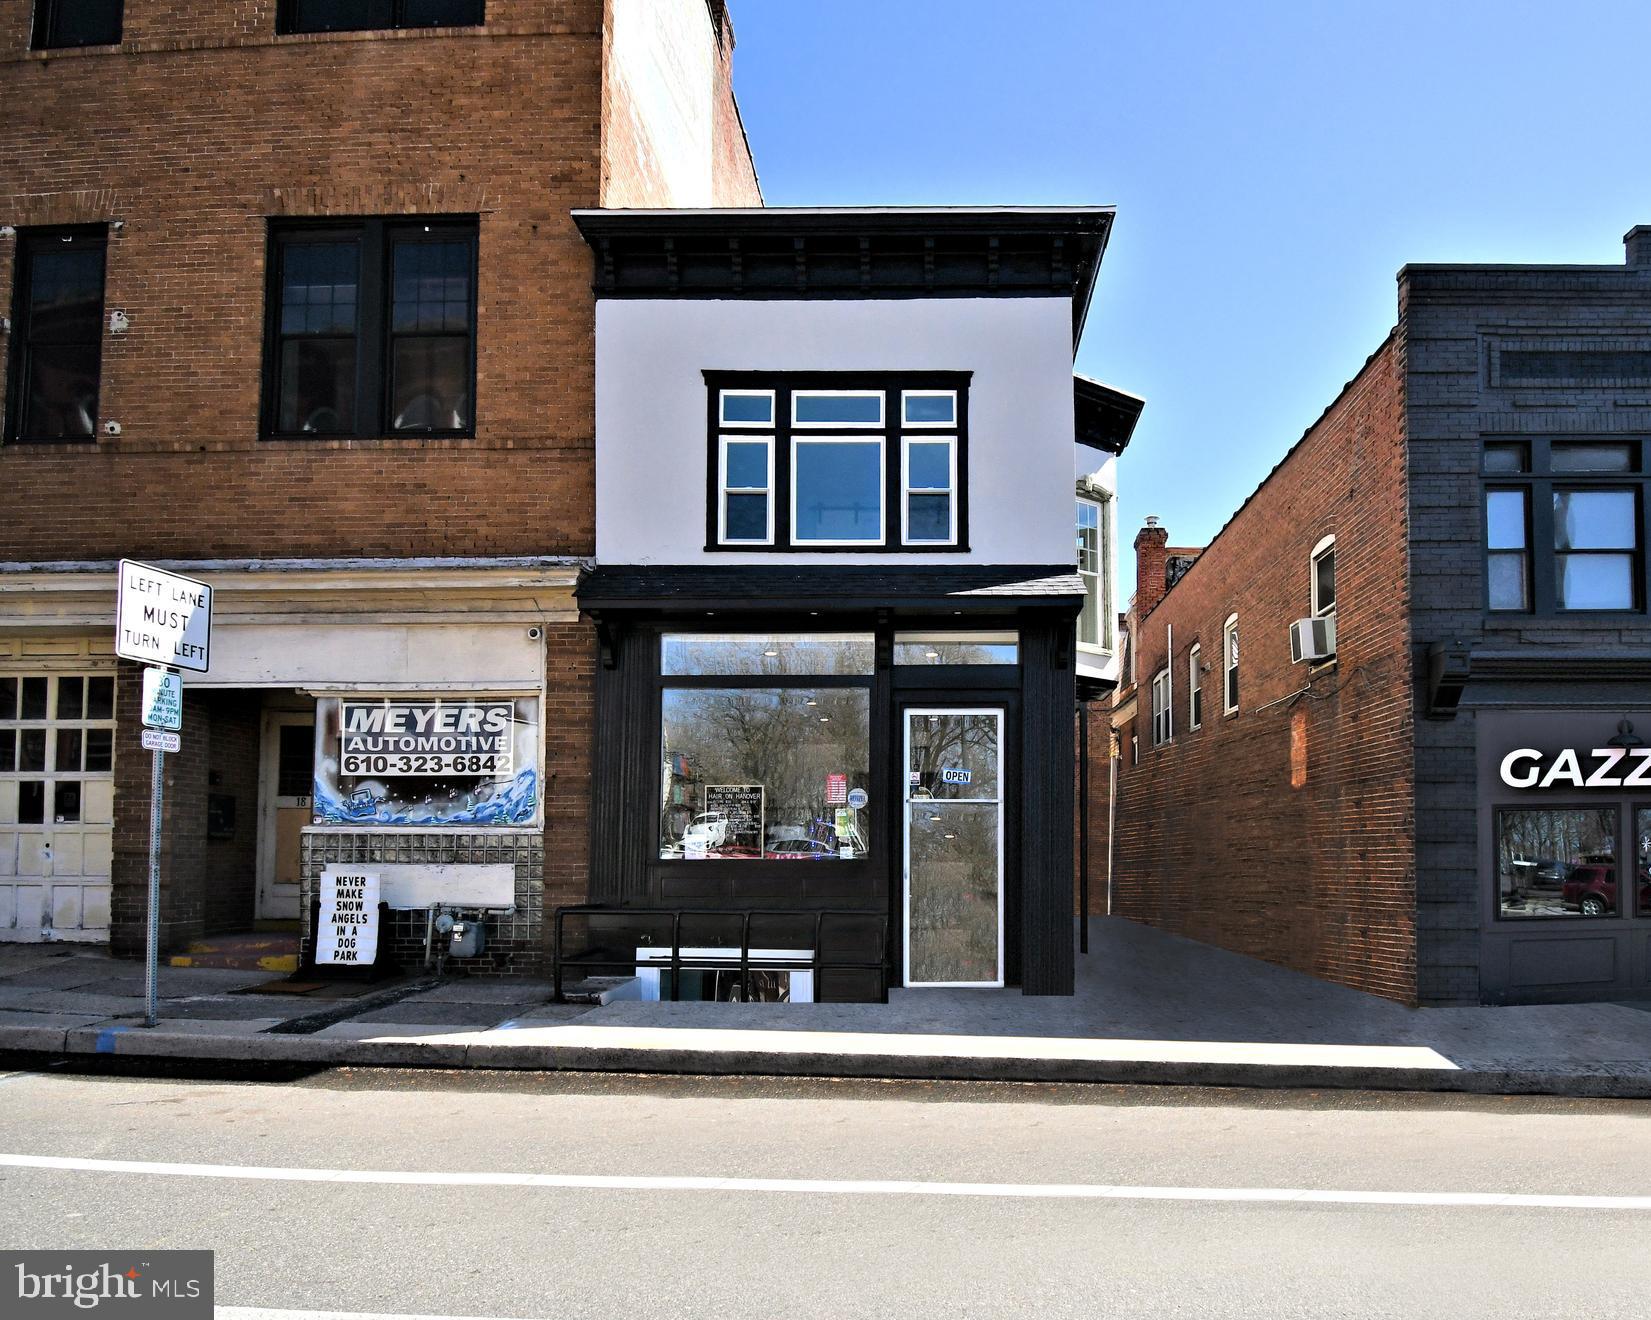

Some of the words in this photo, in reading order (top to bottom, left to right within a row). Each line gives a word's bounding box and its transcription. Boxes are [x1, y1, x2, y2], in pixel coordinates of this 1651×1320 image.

[131, 576, 162, 597] LEFT
[173, 588, 205, 609] LANE
[144, 605, 189, 631] MUST
[125, 629, 159, 650] TURN
[174, 641, 205, 660] LEFT
[151, 696, 177, 708] ARKING
[350, 708, 508, 733] MEYERS
[145, 740, 163, 748] GARAGE
[164, 742, 177, 750] DOOR
[347, 737, 508, 751] AUTOMOTIVE
[344, 755, 511, 773] 610-323-6842
[1500, 748, 1651, 788] GAZZ
[945, 771, 969, 782] OPEN
[296, 797, 307, 807] 18
[336, 876, 366, 887] NEVER
[336, 889, 363, 899] MAKE
[336, 901, 363, 911] SNOW
[331, 913, 368, 924] ANGELS
[336, 926, 346, 936] IN
[351, 926, 358, 936] A
[338, 938, 356, 948] DOG
[333, 950, 358, 961] PARK
